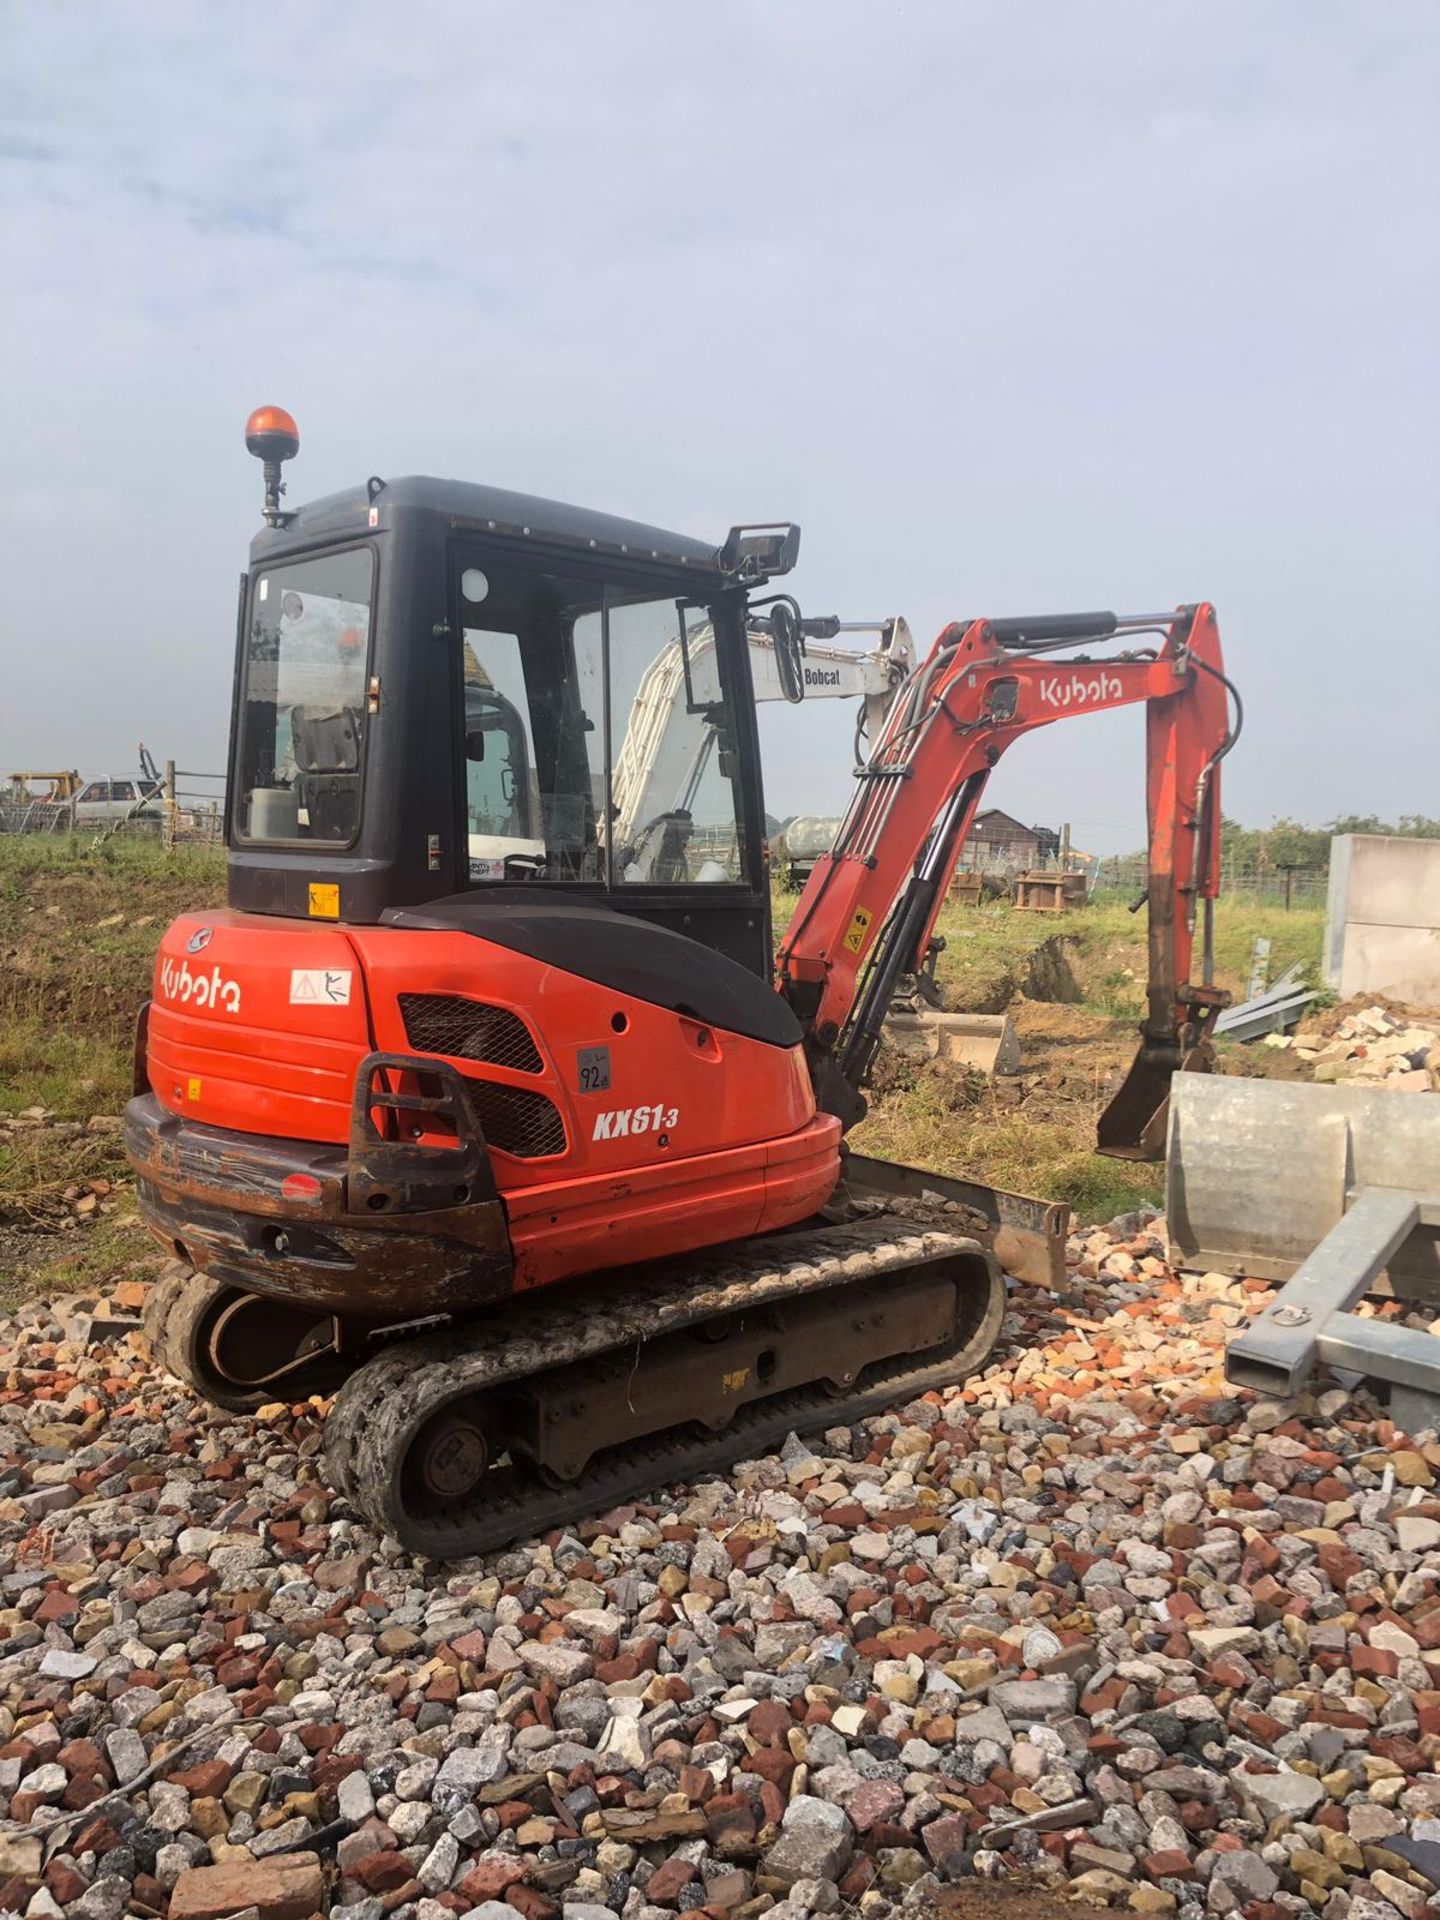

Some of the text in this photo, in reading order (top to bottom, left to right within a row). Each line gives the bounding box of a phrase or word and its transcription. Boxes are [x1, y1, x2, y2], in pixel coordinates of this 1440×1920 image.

[804, 668, 840, 685] Bobcat
[1040, 672, 1122, 706] Kubota
[161, 957, 241, 1013] Kubota
[581, 1066, 599, 1088] 92
